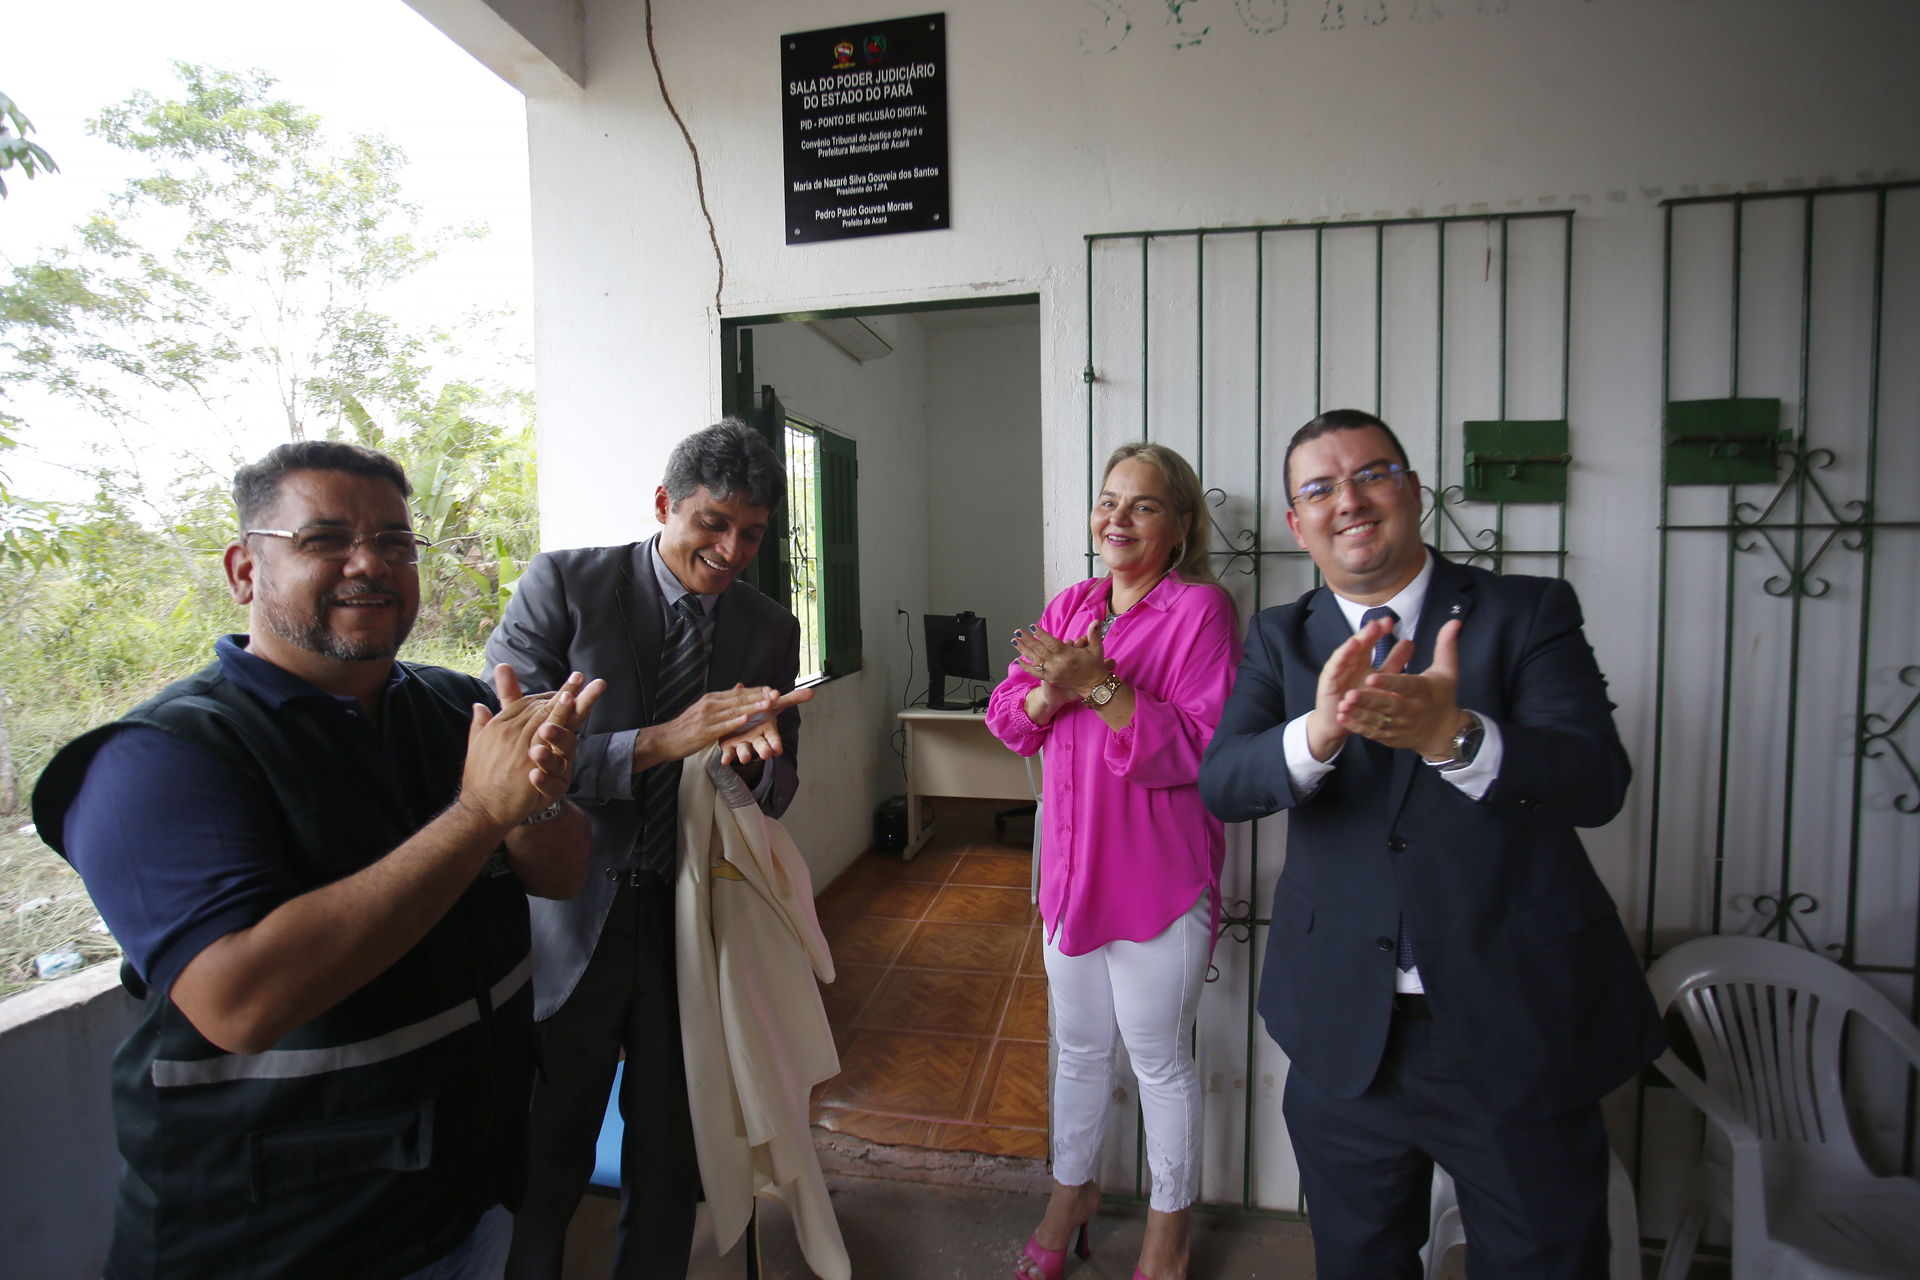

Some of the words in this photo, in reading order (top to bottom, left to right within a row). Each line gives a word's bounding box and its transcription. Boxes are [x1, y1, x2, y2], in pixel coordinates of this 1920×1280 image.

[790, 80, 816, 95] SALA
[820, 77, 834, 91] DO
[837, 71, 872, 88] PODER
[876, 63, 935, 83] JUDICIÁRIO
[804, 96, 818, 109] DO
[822, 90, 863, 106] ESTADO
[866, 87, 881, 101] DO
[884, 81, 913, 99] PARÁ
[801, 120, 812, 130] PID
[818, 116, 844, 128] PONTO
[846, 114, 855, 124] DE
[858, 108, 895, 123] INCLUSÃO
[898, 105, 927, 117] DIGITAL
[801, 138, 830, 150] Convênio
[832, 134, 857, 146] Tribunal
[859, 133, 866, 142] de
[868, 130, 891, 142] Justiça
[893, 129, 901, 138] do
[903, 126, 917, 136] Pará
[818, 147, 848, 158] Prefeitura
[850, 142, 879, 154] Municipal
[881, 141, 889, 150] de
[891, 138, 909, 148] Acará
[794, 181, 812, 192] Maria
[814, 180, 822, 189] de
[824, 176, 847, 188] Nazaré
[849, 174, 866, 184] Silva
[868, 171, 896, 182] Gouveia
[898, 169, 911, 179] dos
[914, 167, 938, 178] Santos
[837, 185, 864, 196] Presidente
[865, 184, 872, 192] do
[874, 183, 888, 192] TJPA
[815, 209, 835, 220] Pedro
[837, 207, 857, 218] Paulo
[858, 204, 885, 215] Gouvea
[887, 201, 913, 212] Moraes
[842, 218, 862, 228] Prefeito
[872, 215, 887, 224] Acará
